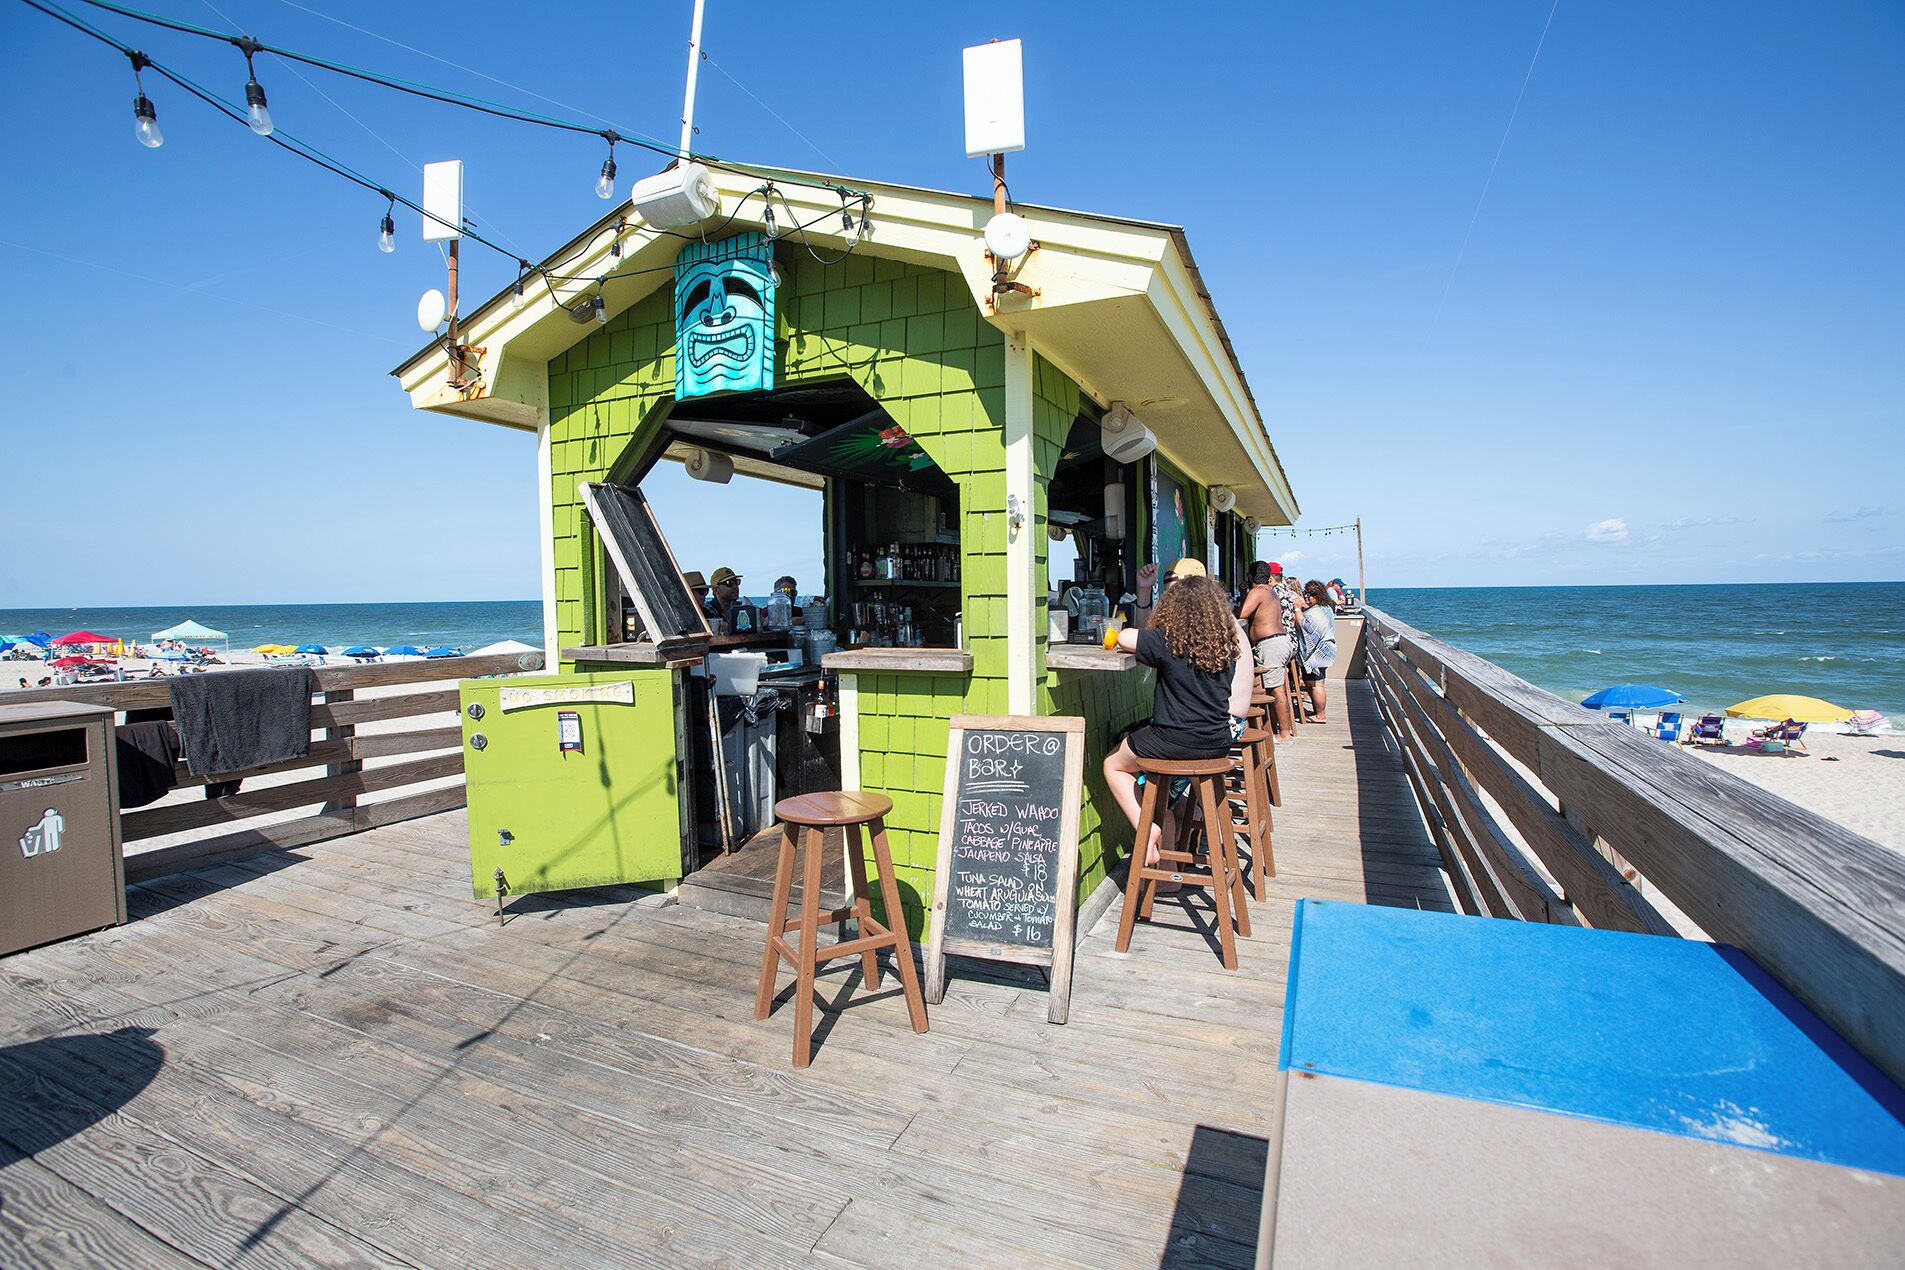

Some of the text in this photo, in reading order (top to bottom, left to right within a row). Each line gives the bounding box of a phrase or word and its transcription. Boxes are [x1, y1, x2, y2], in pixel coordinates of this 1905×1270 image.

[509, 686, 624, 703] NO SMOKING
[968, 734, 1060, 755] ORDER @
[960, 799, 1059, 821] JERKED WAHOO
[960, 818, 994, 834] TACOS
[961, 834, 1058, 853] CABBAGE PINEAPPLE
[958, 846, 1047, 867] JALAPENO SALSA
[957, 871, 1044, 892] TUNA SALAD ON
[955, 886, 988, 899] WHEAT
[957, 898, 1001, 911] TOMATO
[1003, 902, 1035, 913] SERVED
[968, 910, 1014, 923] CUCUMBER
[1021, 912, 1053, 925] TOMATO
[968, 920, 1003, 931] SALAD
